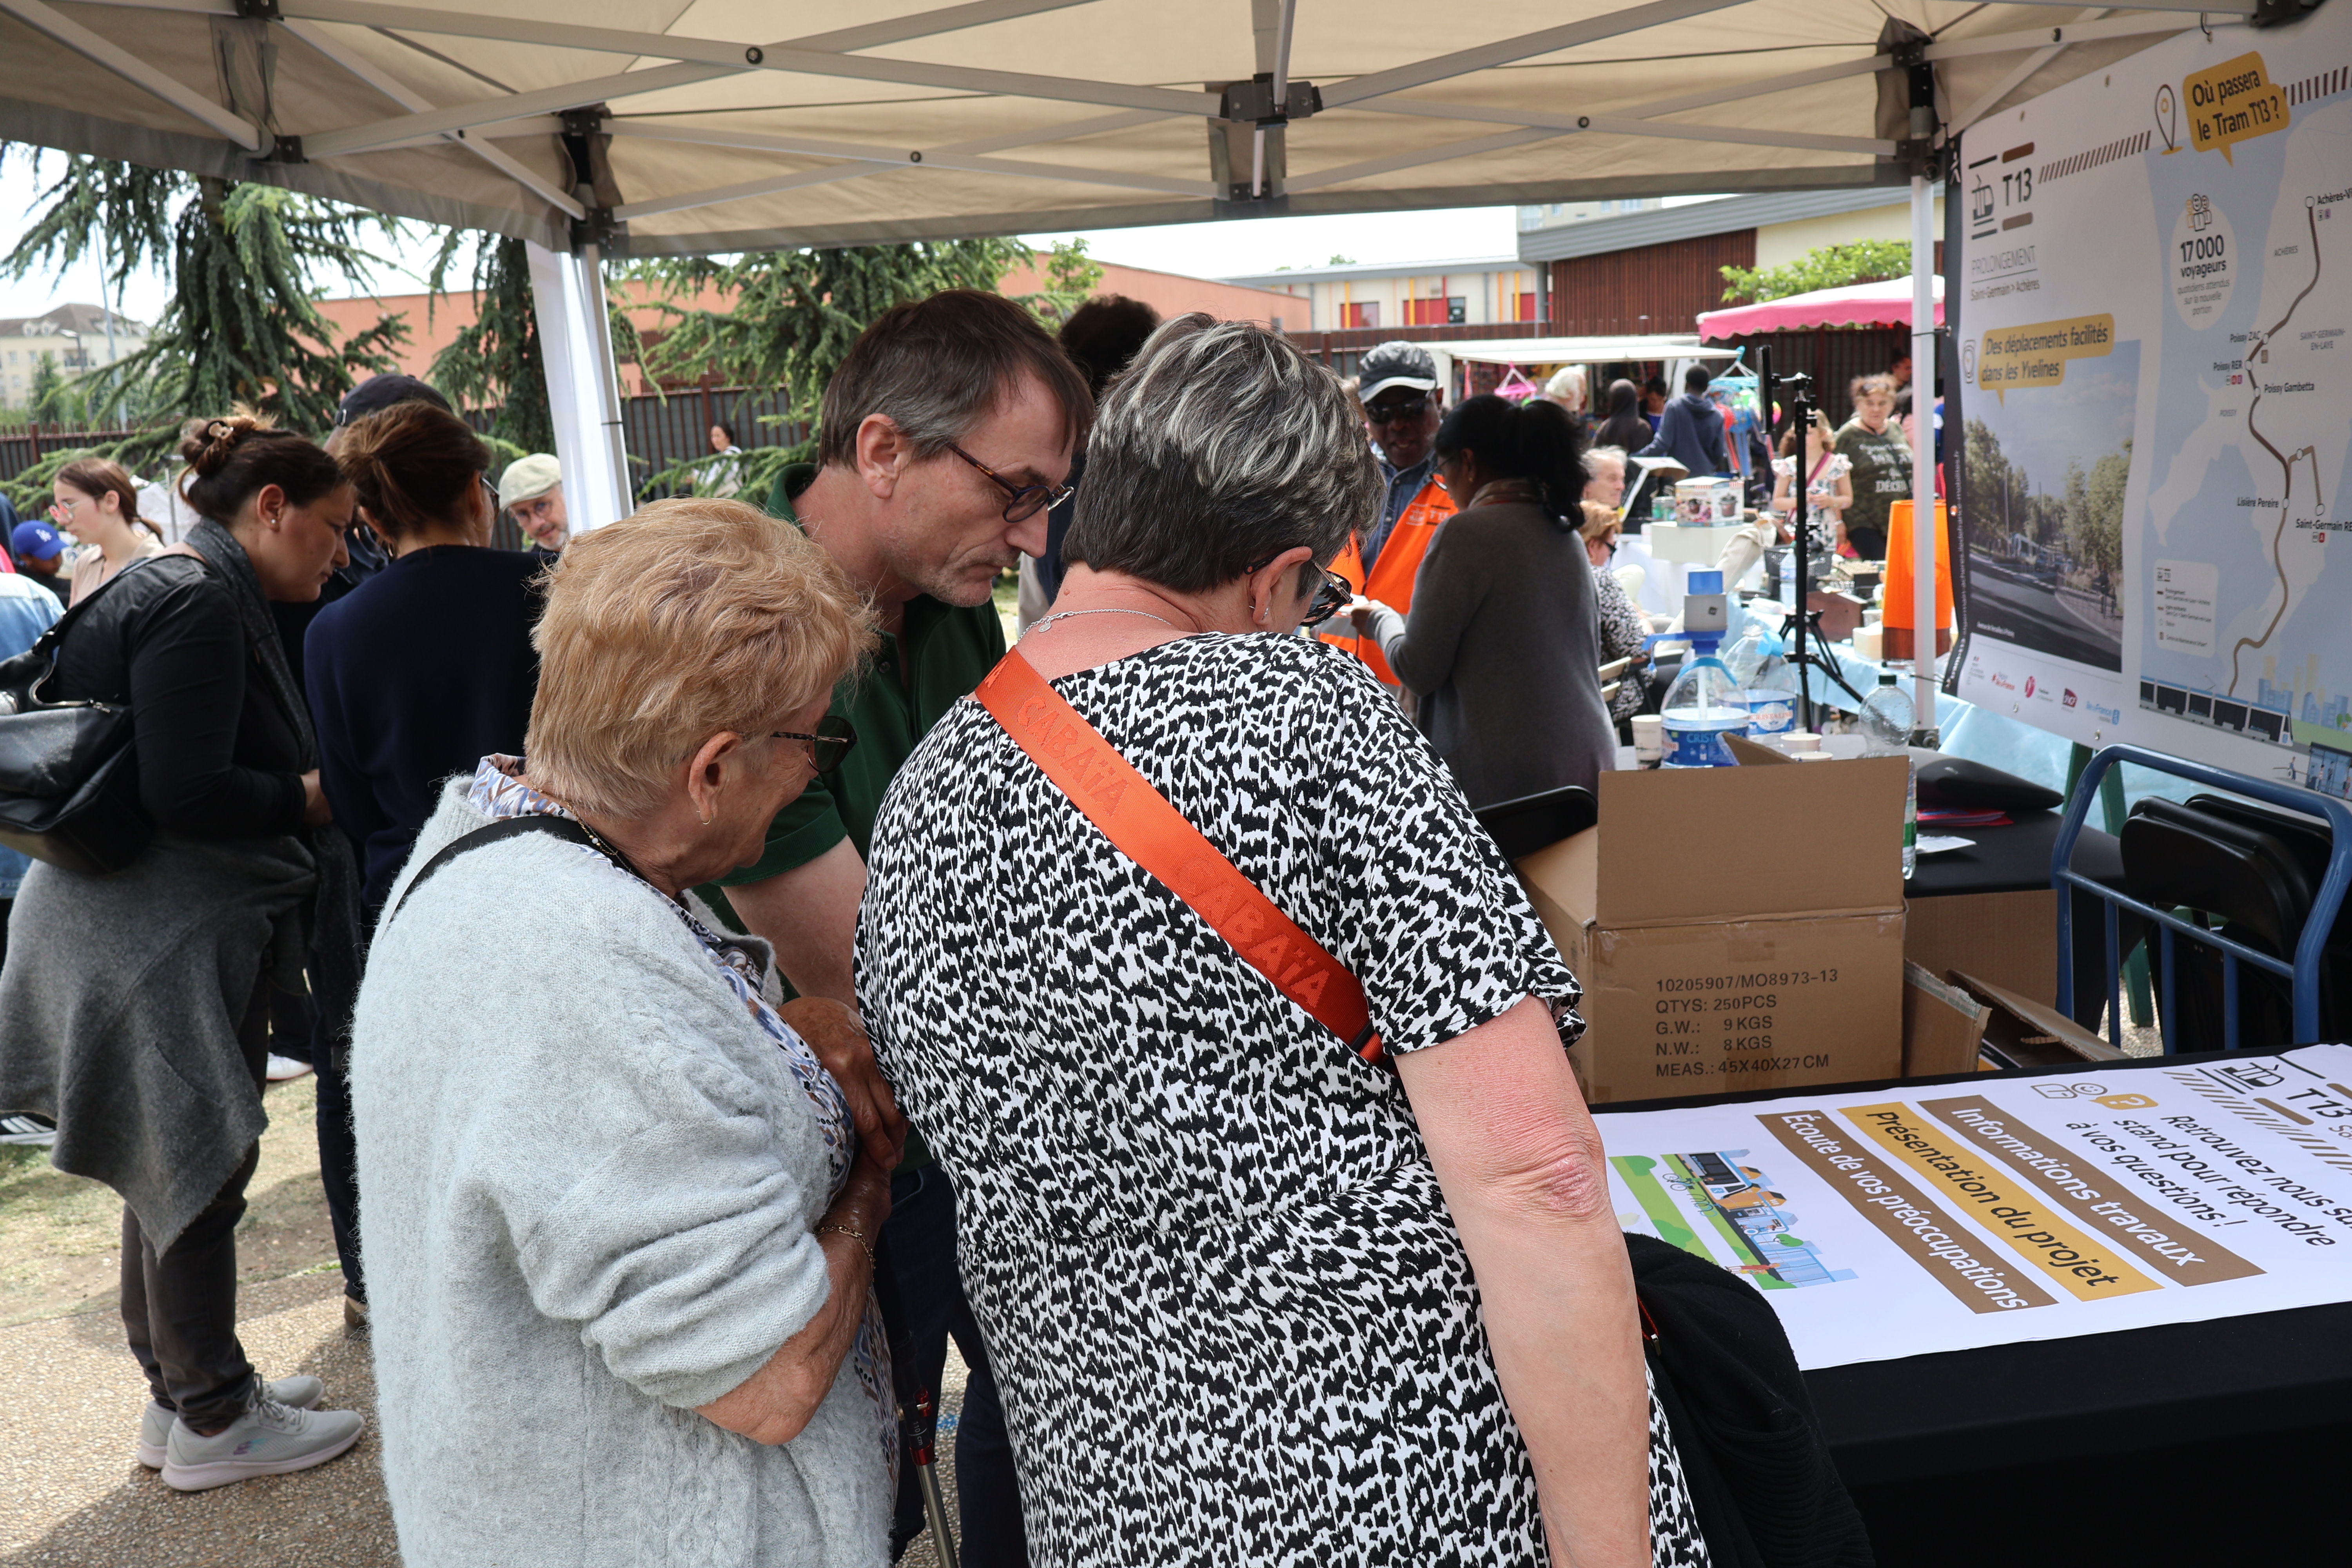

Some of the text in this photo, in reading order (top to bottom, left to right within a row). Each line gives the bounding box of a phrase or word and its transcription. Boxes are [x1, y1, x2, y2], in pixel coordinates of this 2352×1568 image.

[2192, 70, 2261, 107] Où passera
[2197, 118, 2211, 142] le
[2213, 112, 2250, 136] Tram
[2249, 98, 2271, 125] T13
[2002, 167, 2032, 207] T13
[1971, 245, 2036, 276] PROLONGEMENT
[2180, 259, 2227, 279] voyageurs
[2016, 278, 2040, 292] Achères
[1985, 322, 2109, 357] Des déplacements facilités
[2230, 332, 2247, 344] Poissy
[1982, 358, 2060, 382] dans les Yvelines
[2213, 360, 2243, 372] Poissy RER
[2264, 381, 2315, 395] Poissy Gambetta
[2295, 518, 2343, 531] Saint-Germain
[1655, 998, 1708, 1014] QTYS:
[1655, 1015, 1773, 1035] G.W.: 9 KGS
[1655, 1035, 1772, 1056] N.W.: 8 KGS
[1655, 1062, 1714, 1077] MEAS.:
[2285, 1087, 2352, 1118] T13
[2065, 1122, 2099, 1130] à
[2082, 1131, 2126, 1152] vos
[2110, 1154, 2227, 1220] questions
[2113, 1118, 2336, 1246] stand pour répondre
[2159, 1115, 2352, 1229] Retrouvez nous su
[1866, 1112, 2120, 1287] Présentation du projet
[1951, 1108, 2206, 1267] Informations travaux
[1781, 1114, 2029, 1309] Écoute de vos préoccupations
[917, 1436, 923, 1446] cm
